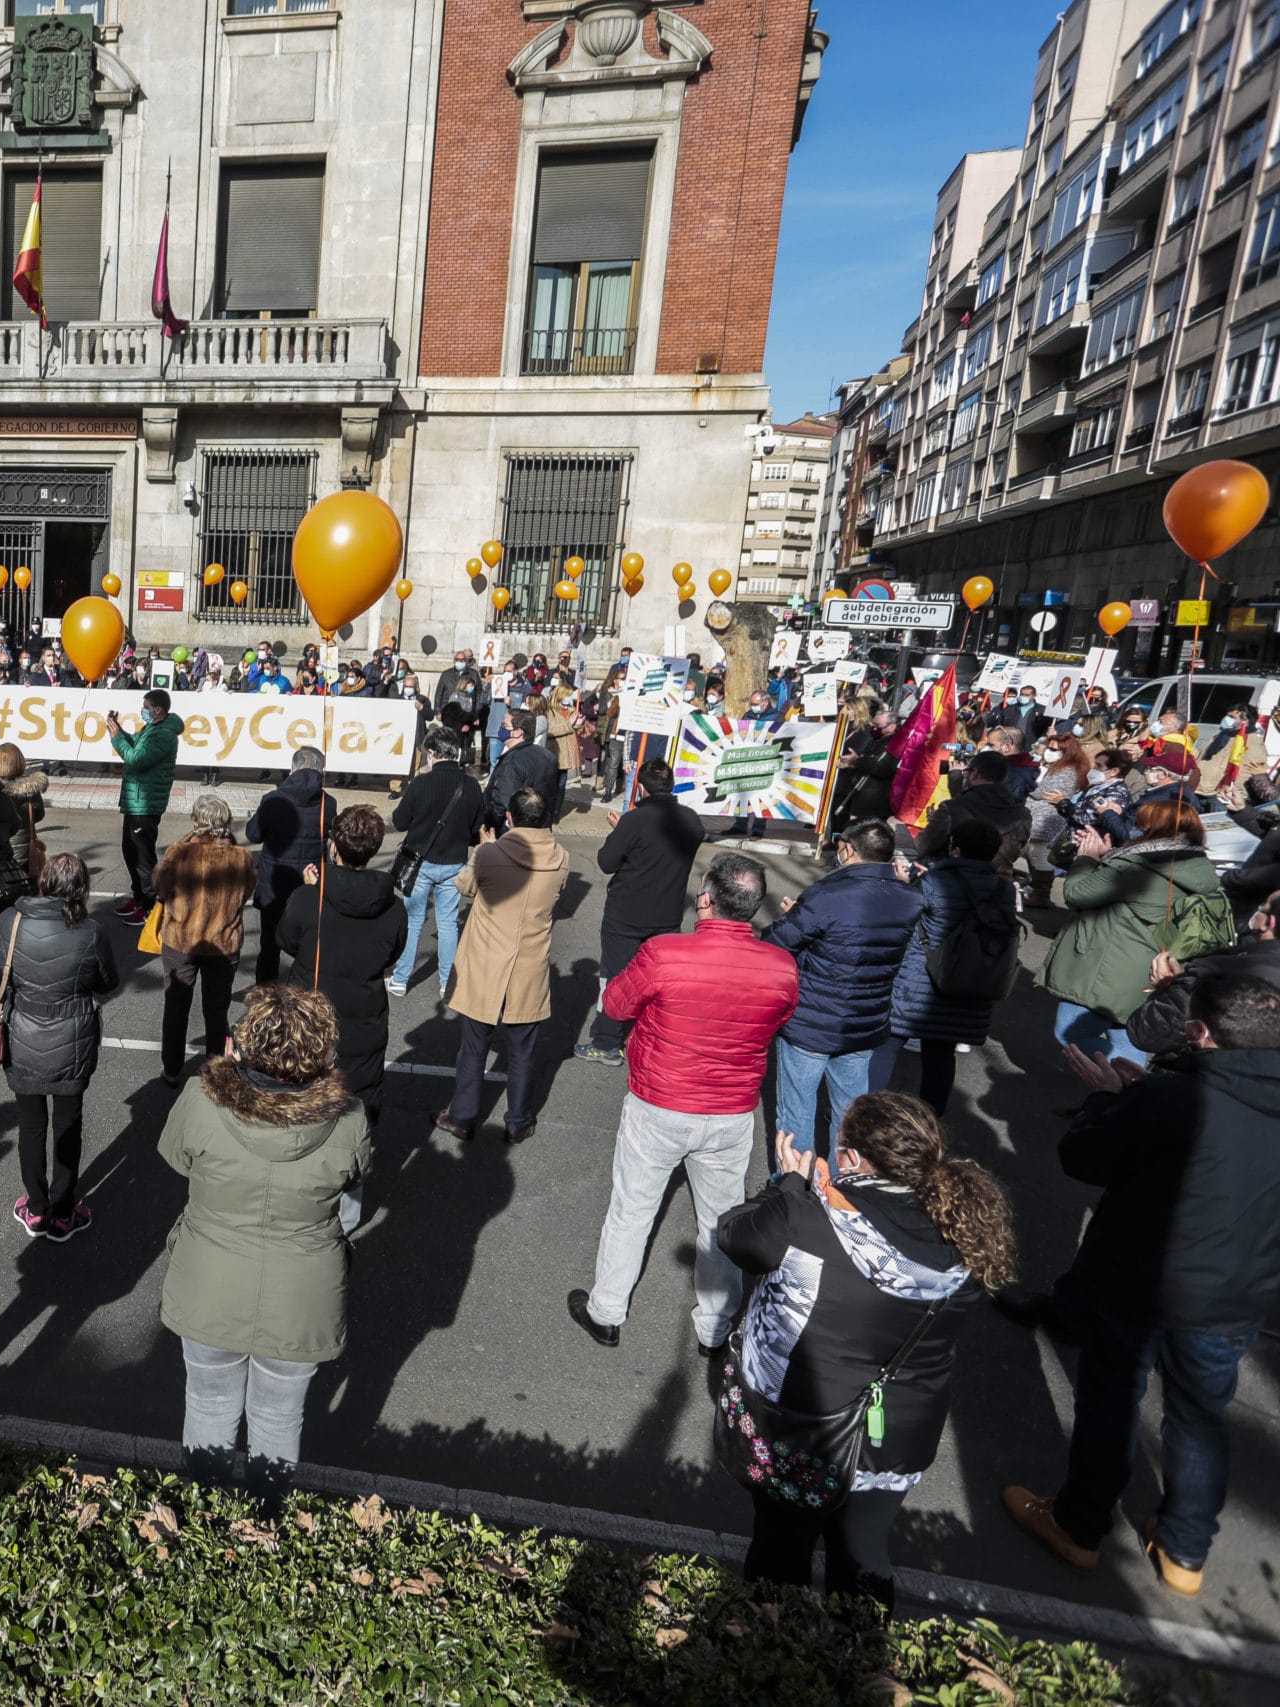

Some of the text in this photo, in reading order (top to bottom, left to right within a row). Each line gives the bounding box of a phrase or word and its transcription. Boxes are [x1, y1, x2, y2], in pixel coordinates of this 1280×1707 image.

[51, 421, 73, 433] DEL
[77, 422, 136, 433] GOBIERNO
[843, 602, 937, 615] subdelegación
[841, 611, 921, 624] del gobierno
